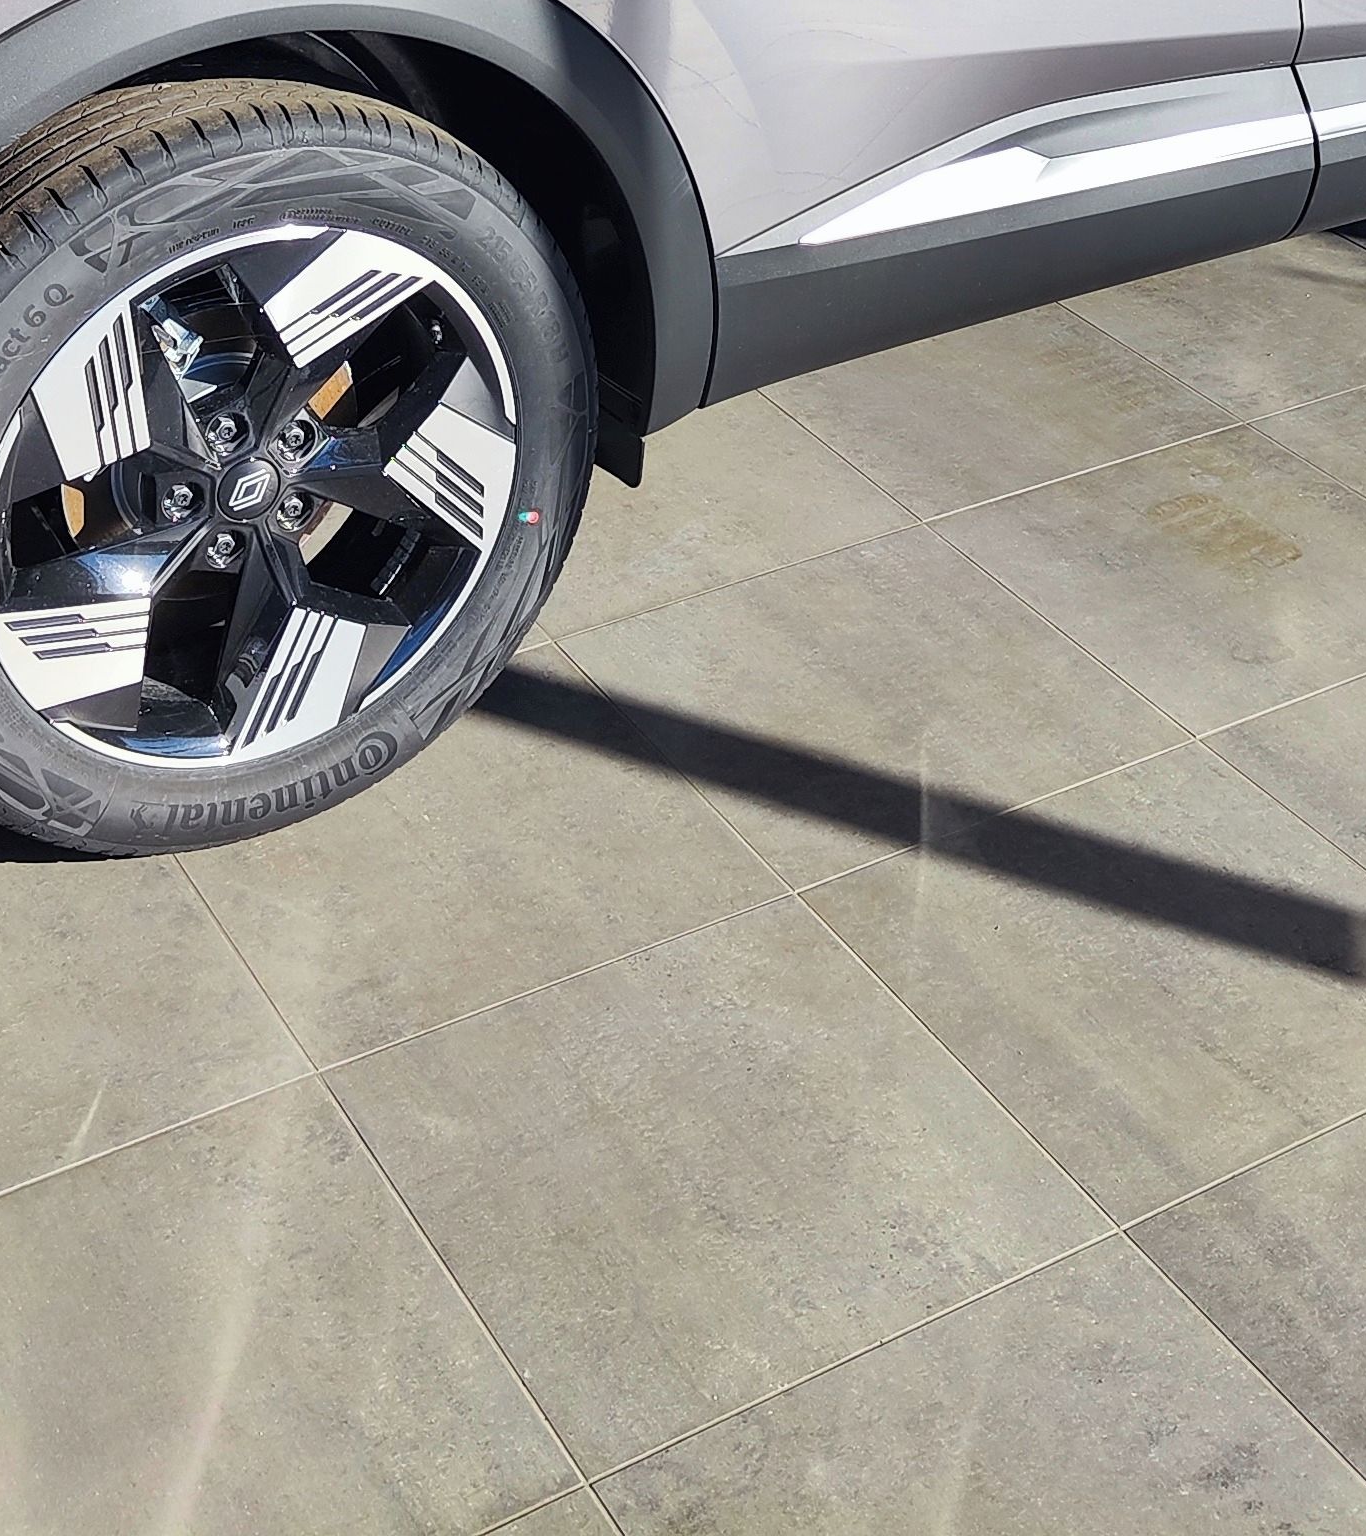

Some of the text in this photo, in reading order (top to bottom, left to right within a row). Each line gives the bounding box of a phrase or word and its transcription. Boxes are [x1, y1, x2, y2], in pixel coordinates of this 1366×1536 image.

[22, 303, 47, 328] 6
[43, 283, 75, 307] Q
[161, 730, 398, 838] Continental
